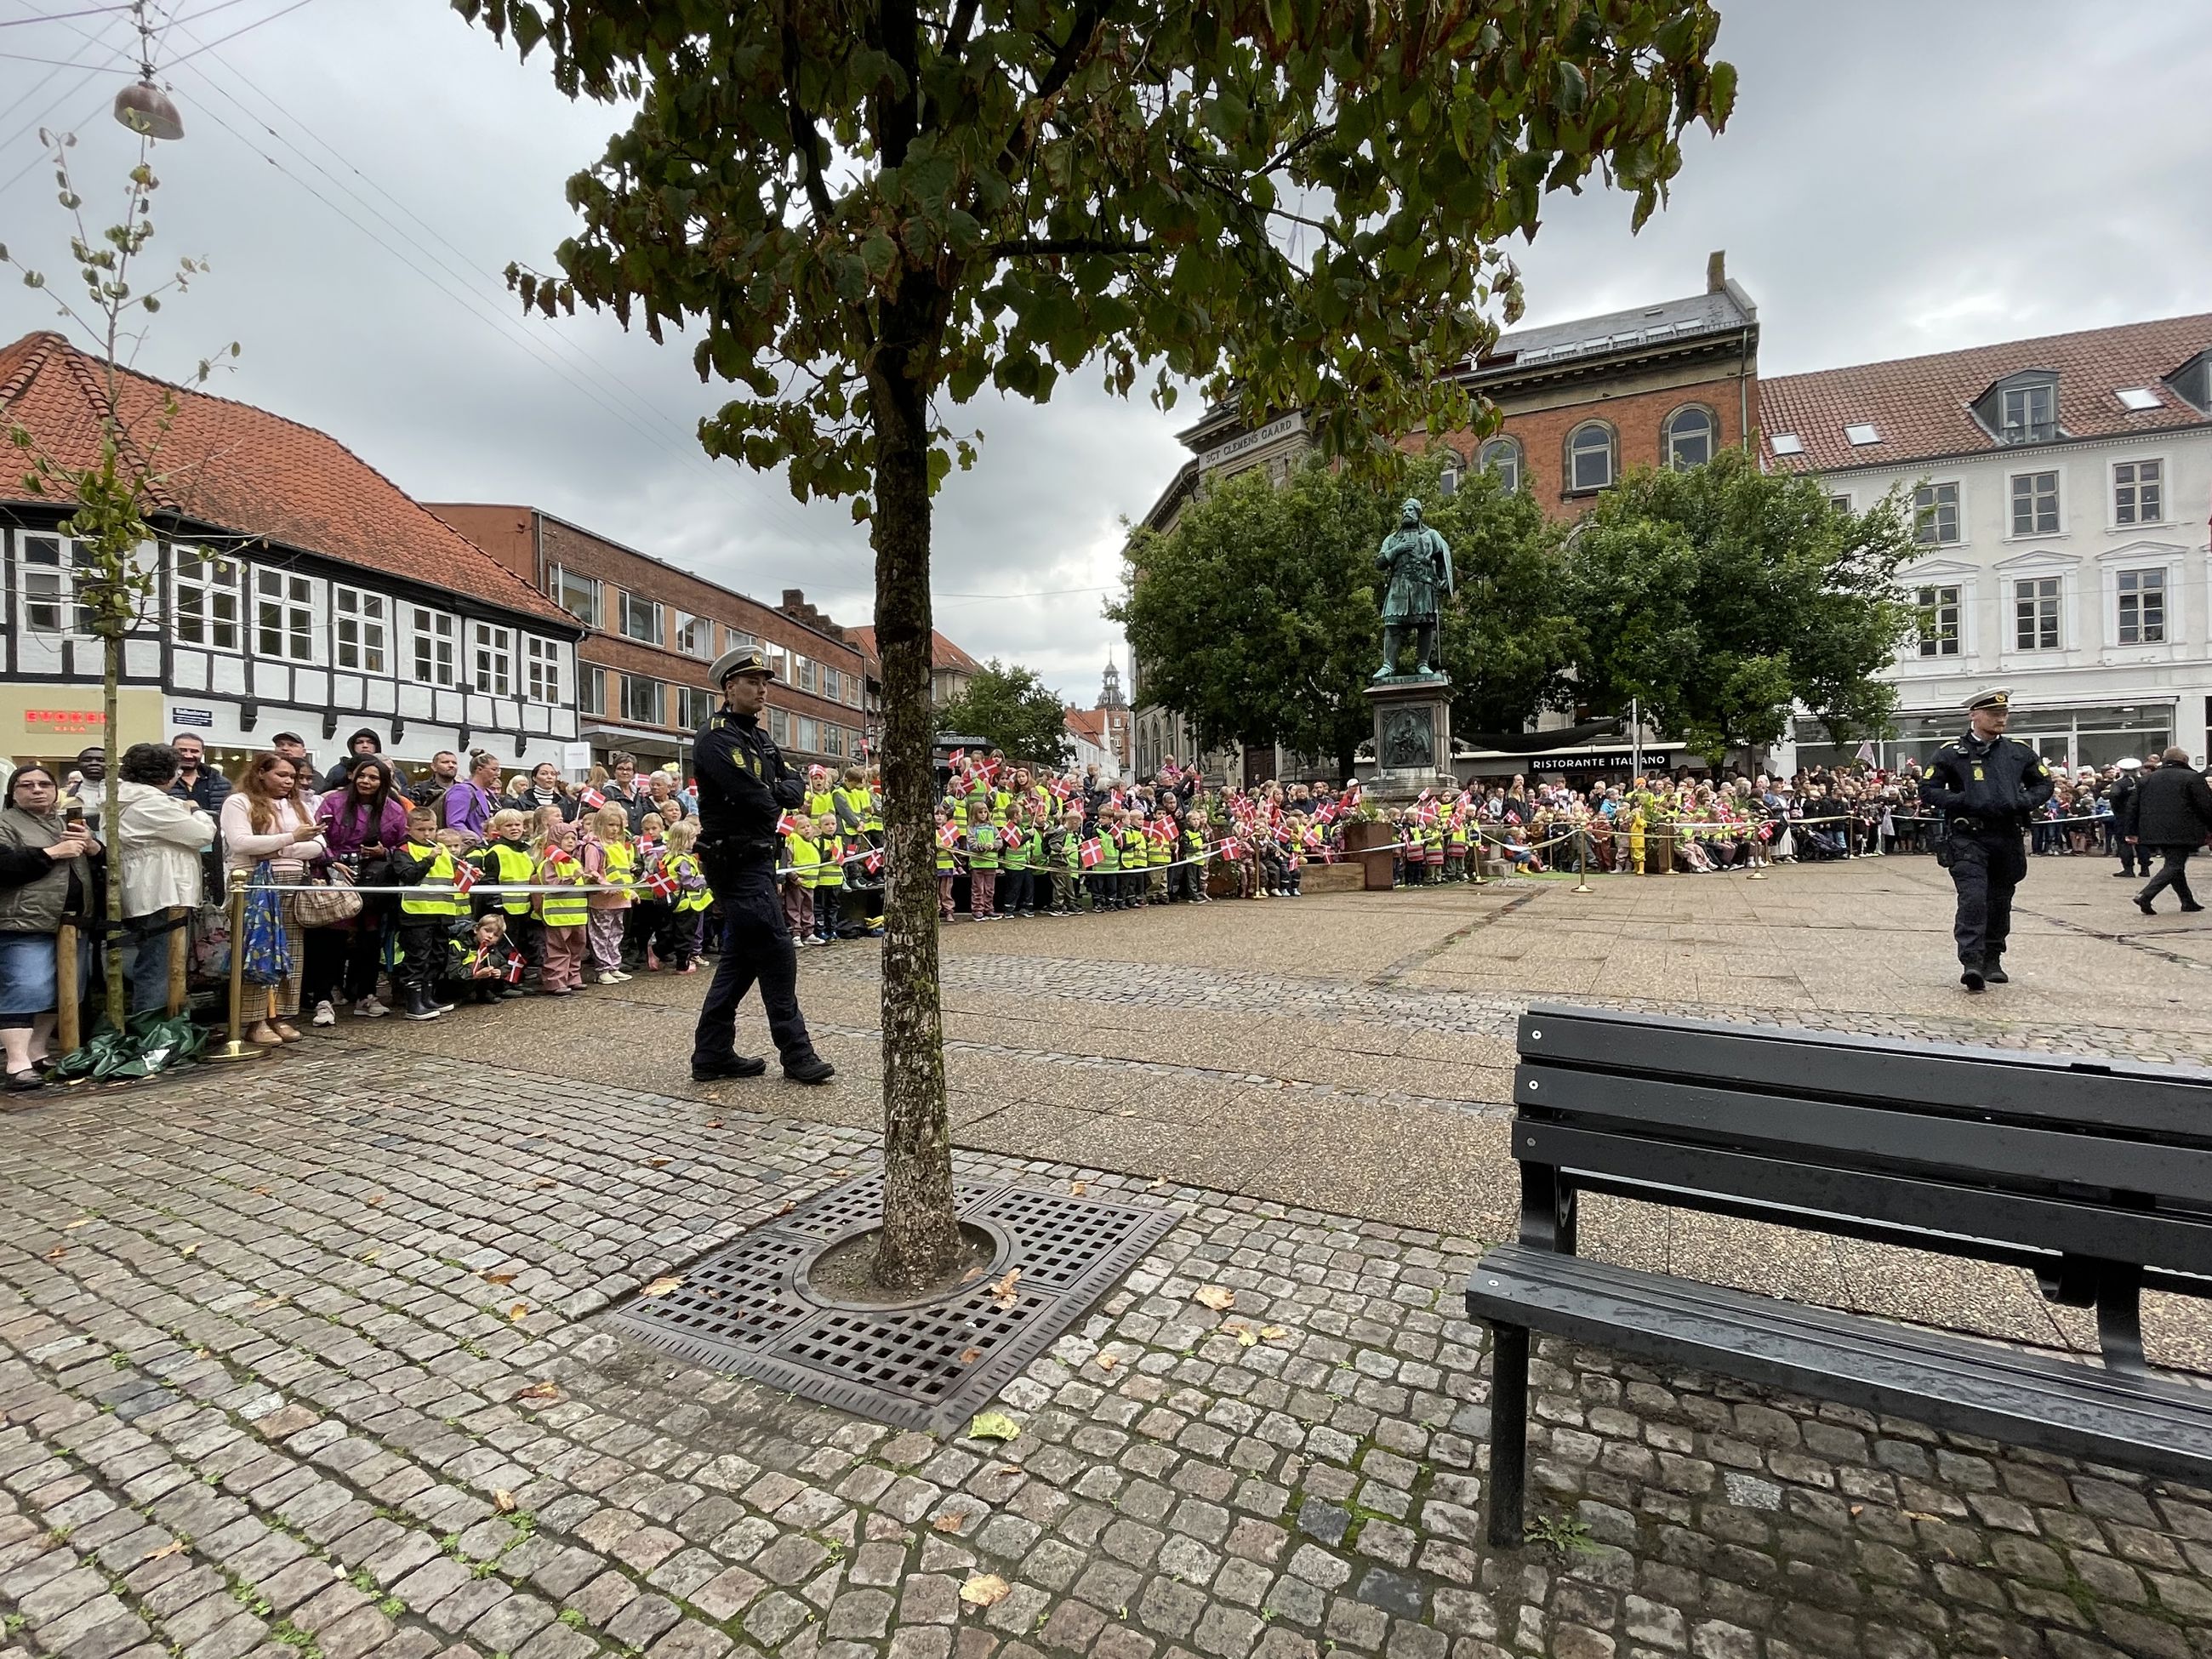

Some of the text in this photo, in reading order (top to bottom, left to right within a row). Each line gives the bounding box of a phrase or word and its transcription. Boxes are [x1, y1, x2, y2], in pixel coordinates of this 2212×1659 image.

[1206, 420, 1291, 464] SCT CLEMENS GAARD
[1533, 755, 1665, 768] RISTORANTE ITALANO
